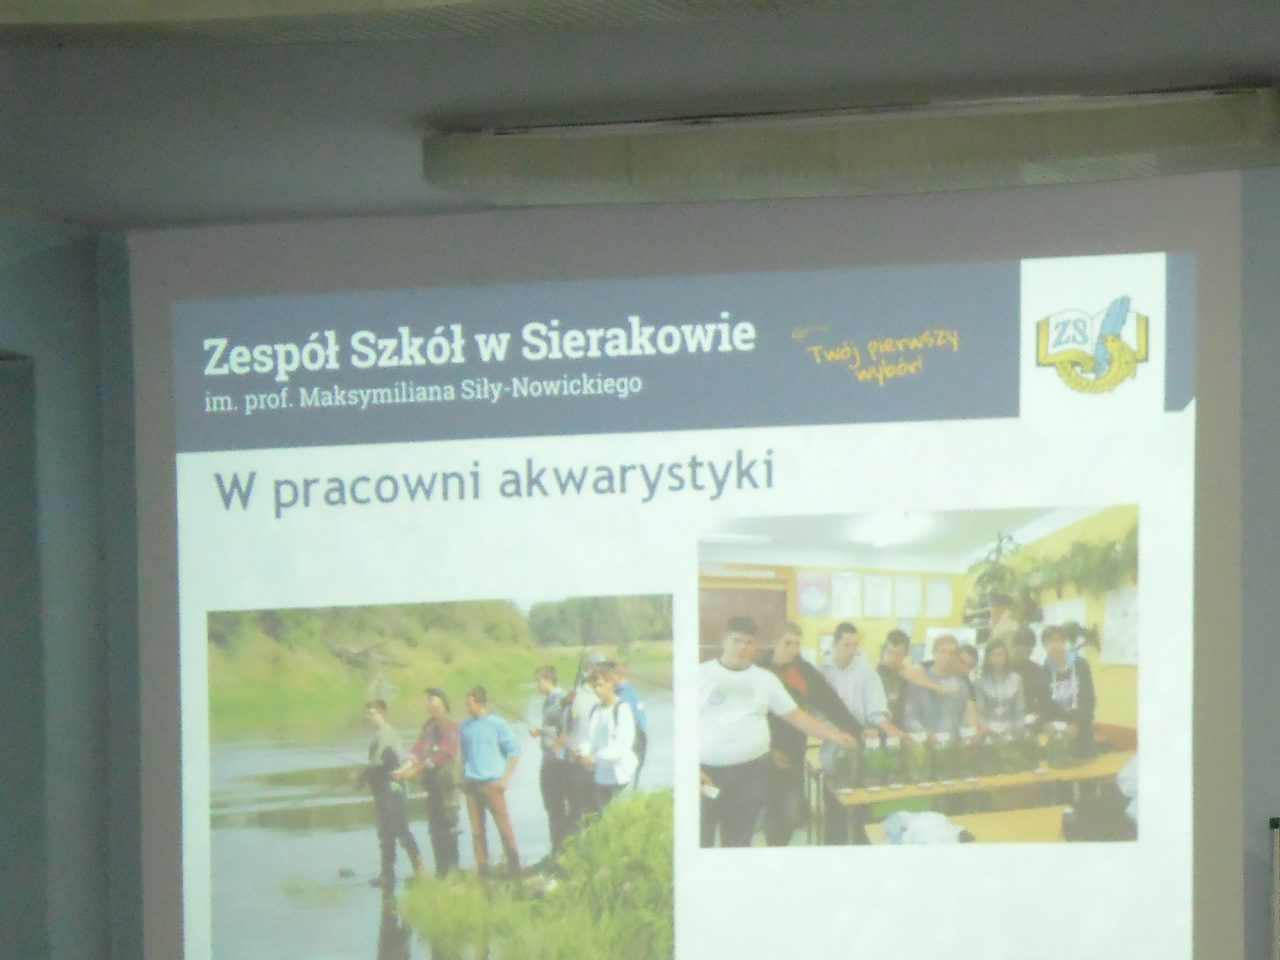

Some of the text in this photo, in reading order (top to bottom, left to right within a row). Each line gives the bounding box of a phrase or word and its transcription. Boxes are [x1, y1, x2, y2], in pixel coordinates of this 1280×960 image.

[203, 311, 757, 381] Zespół Szkół w Sierakowie
[806, 328, 961, 369] Twój pierwszy
[1053, 316, 1091, 348] ZS
[204, 371, 643, 415] im. prof. Maksymiliana Siły-Nowickiego
[215, 448, 774, 518] W pracowni akwarystyki
